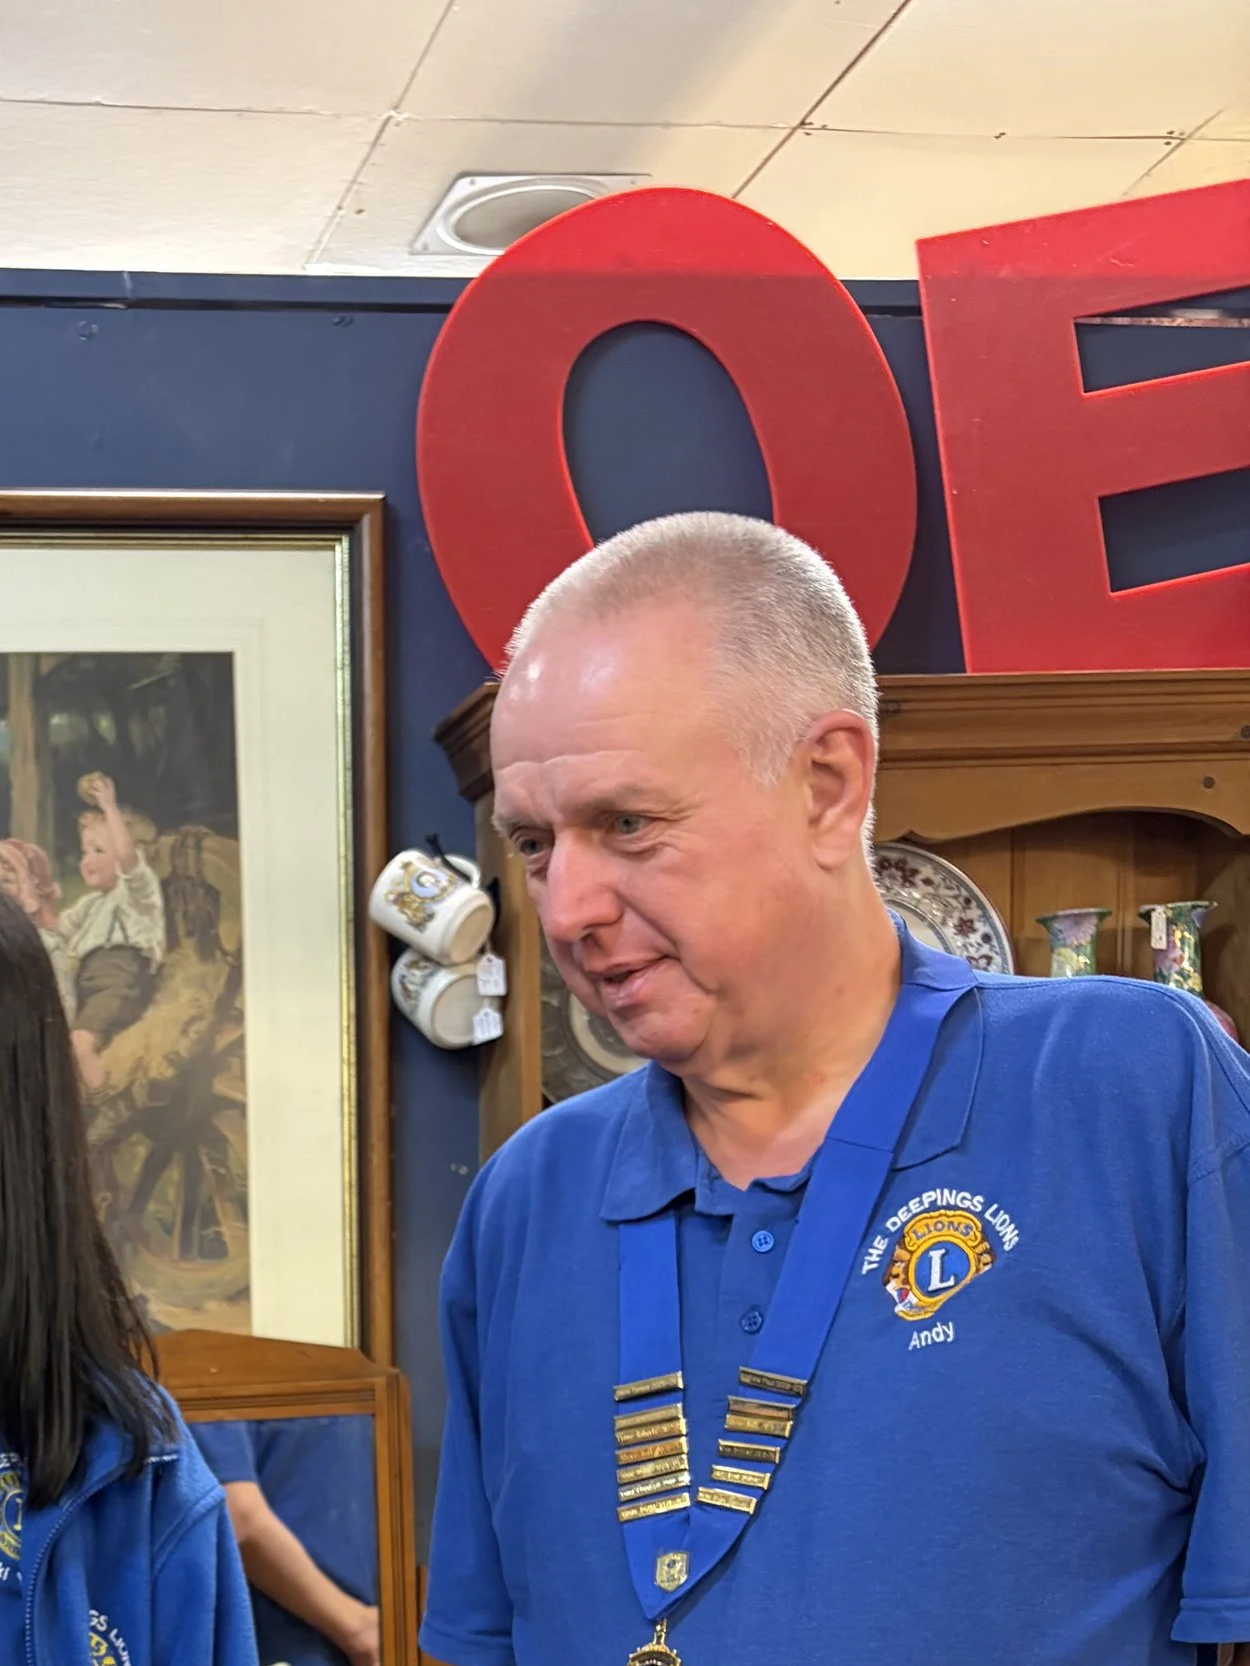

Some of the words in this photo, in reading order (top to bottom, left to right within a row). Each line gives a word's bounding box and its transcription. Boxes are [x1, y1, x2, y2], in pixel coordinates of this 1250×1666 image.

[861, 1235, 889, 1275] THE
[885, 1188, 985, 1233] DEEPINGS
[984, 1203, 1020, 1252] LIONS
[911, 1220, 975, 1241] LIONS
[927, 1248, 955, 1291] L
[908, 1321, 954, 1351] Andy
